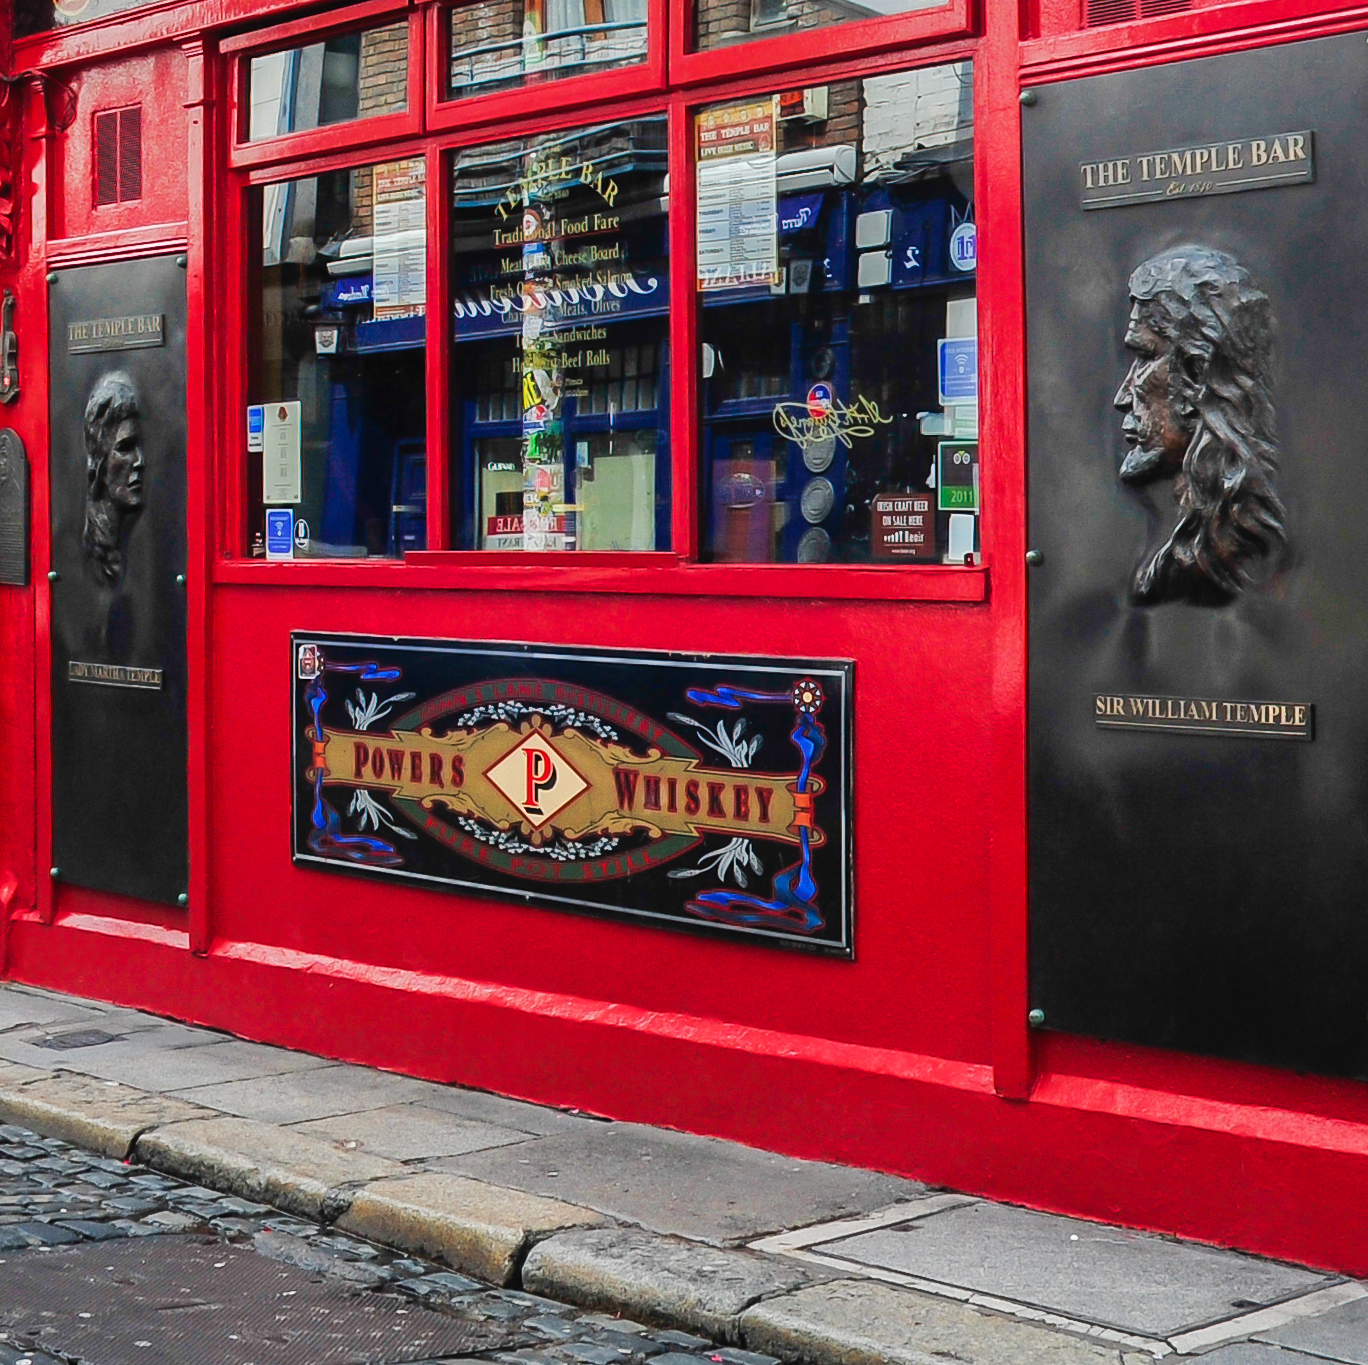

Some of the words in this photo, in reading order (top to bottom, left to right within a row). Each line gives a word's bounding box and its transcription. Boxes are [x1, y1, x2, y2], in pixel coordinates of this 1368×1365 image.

[700, 131, 718, 142] THE
[721, 126, 751, 139] TEMPLE
[753, 122, 771, 133] BAR
[1081, 160, 1132, 189] THE
[1137, 144, 1244, 182] TEMPLE
[1250, 135, 1307, 167] BAR
[578, 161, 619, 208] BAR
[561, 216, 589, 236] Food
[594, 214, 620, 231] Fare
[591, 242, 620, 262] Board
[68, 322, 89, 341] THE
[92, 318, 136, 339] TEMPLE
[137, 315, 162, 333] BAR
[562, 350, 583, 368] Beef
[586, 349, 611, 367] Rolls
[950, 490, 974, 503] 2011
[892, 515, 907, 526] SALE
[493, 683, 544, 698] LANE
[1096, 696, 1126, 717] SIR
[1130, 697, 1219, 722] WILLIAM
[1222, 702, 1307, 726] TEMPLE
[353, 741, 465, 790] POWERS
[521, 747, 558, 816] P
[613, 767, 774, 823] WHISKEY
[425, 816, 489, 859] PURE
[510, 858, 561, 880] POT
[582, 850, 658, 880] STILL
